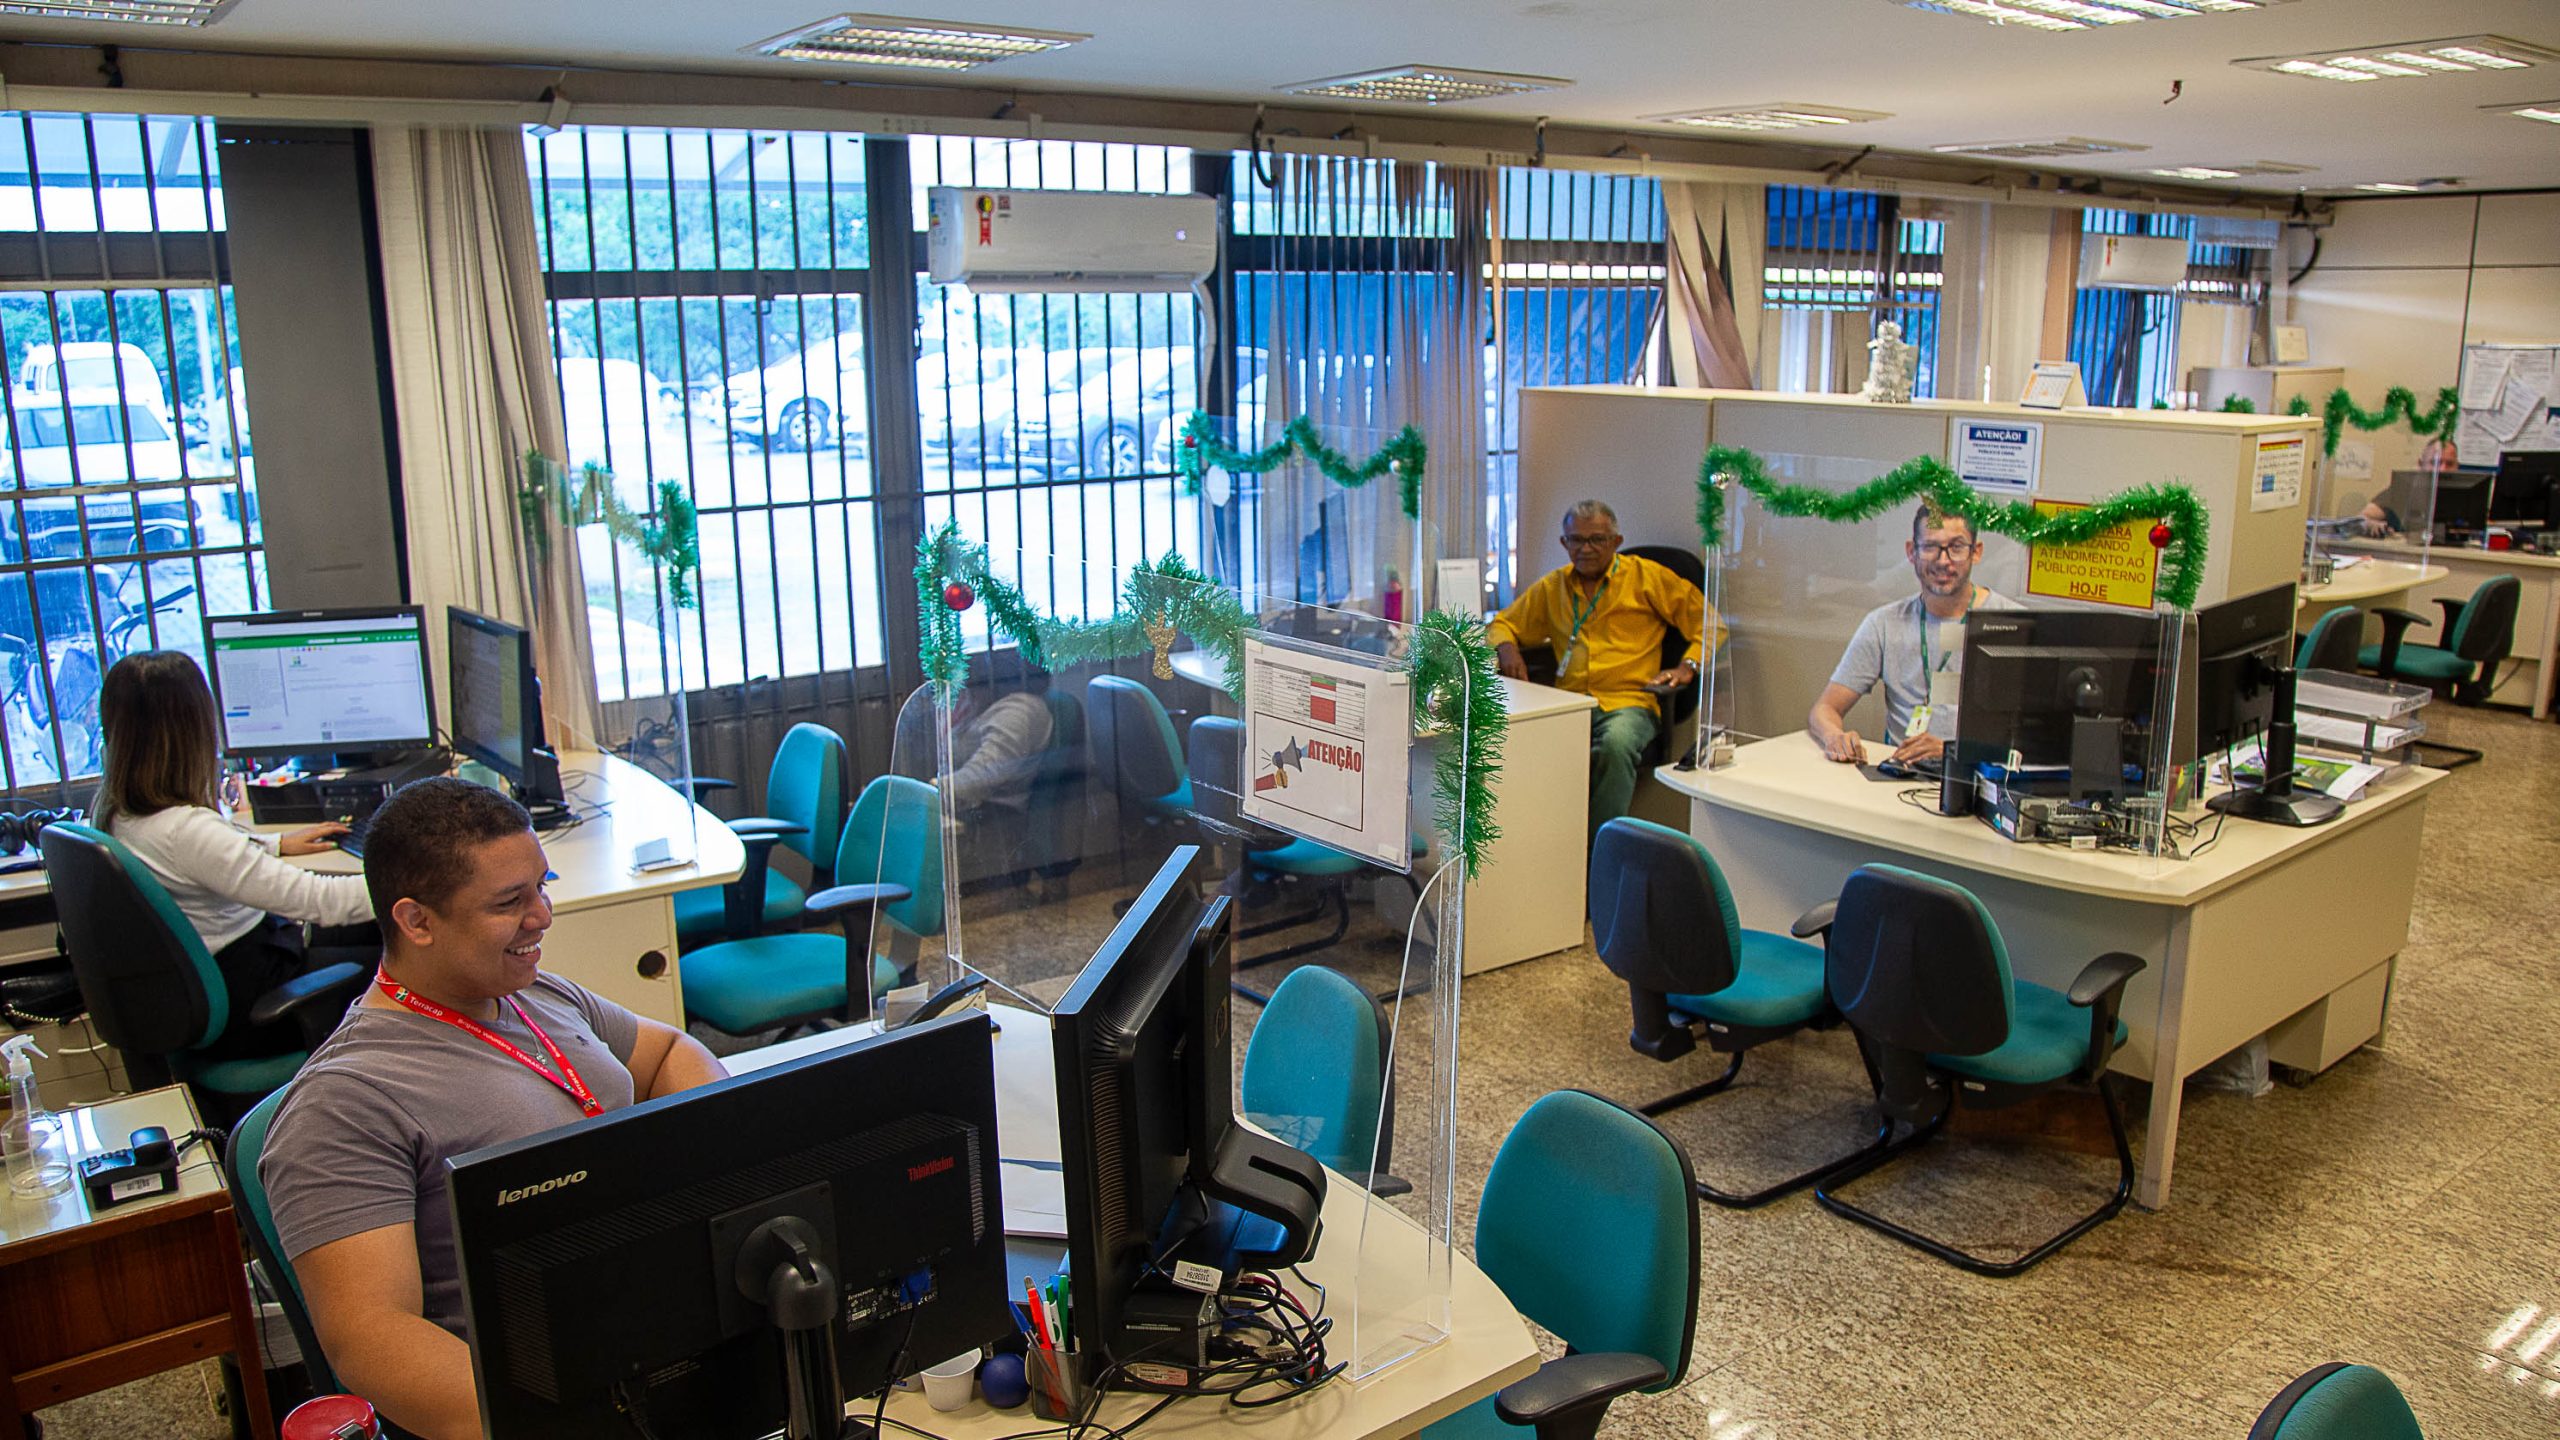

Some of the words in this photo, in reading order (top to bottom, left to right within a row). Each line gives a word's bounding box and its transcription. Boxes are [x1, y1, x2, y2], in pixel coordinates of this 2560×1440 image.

[1975, 430, 2022, 442] ATENÇÃO!
[2040, 547, 2124, 566] ATENDIMENTO
[2127, 557, 2145, 568] AO
[2036, 559, 2086, 576] PÚBLICO
[2089, 567, 2146, 583] EXTERNO
[2069, 581, 2108, 596] HOJE
[1982, 623, 2018, 631] lenovo
[1308, 739, 1361, 773] ATENÇÃO
[409, 996, 443, 1017] Terracap
[907, 1156, 954, 1182] ThinkVision
[497, 1170, 588, 1207] lenovo
